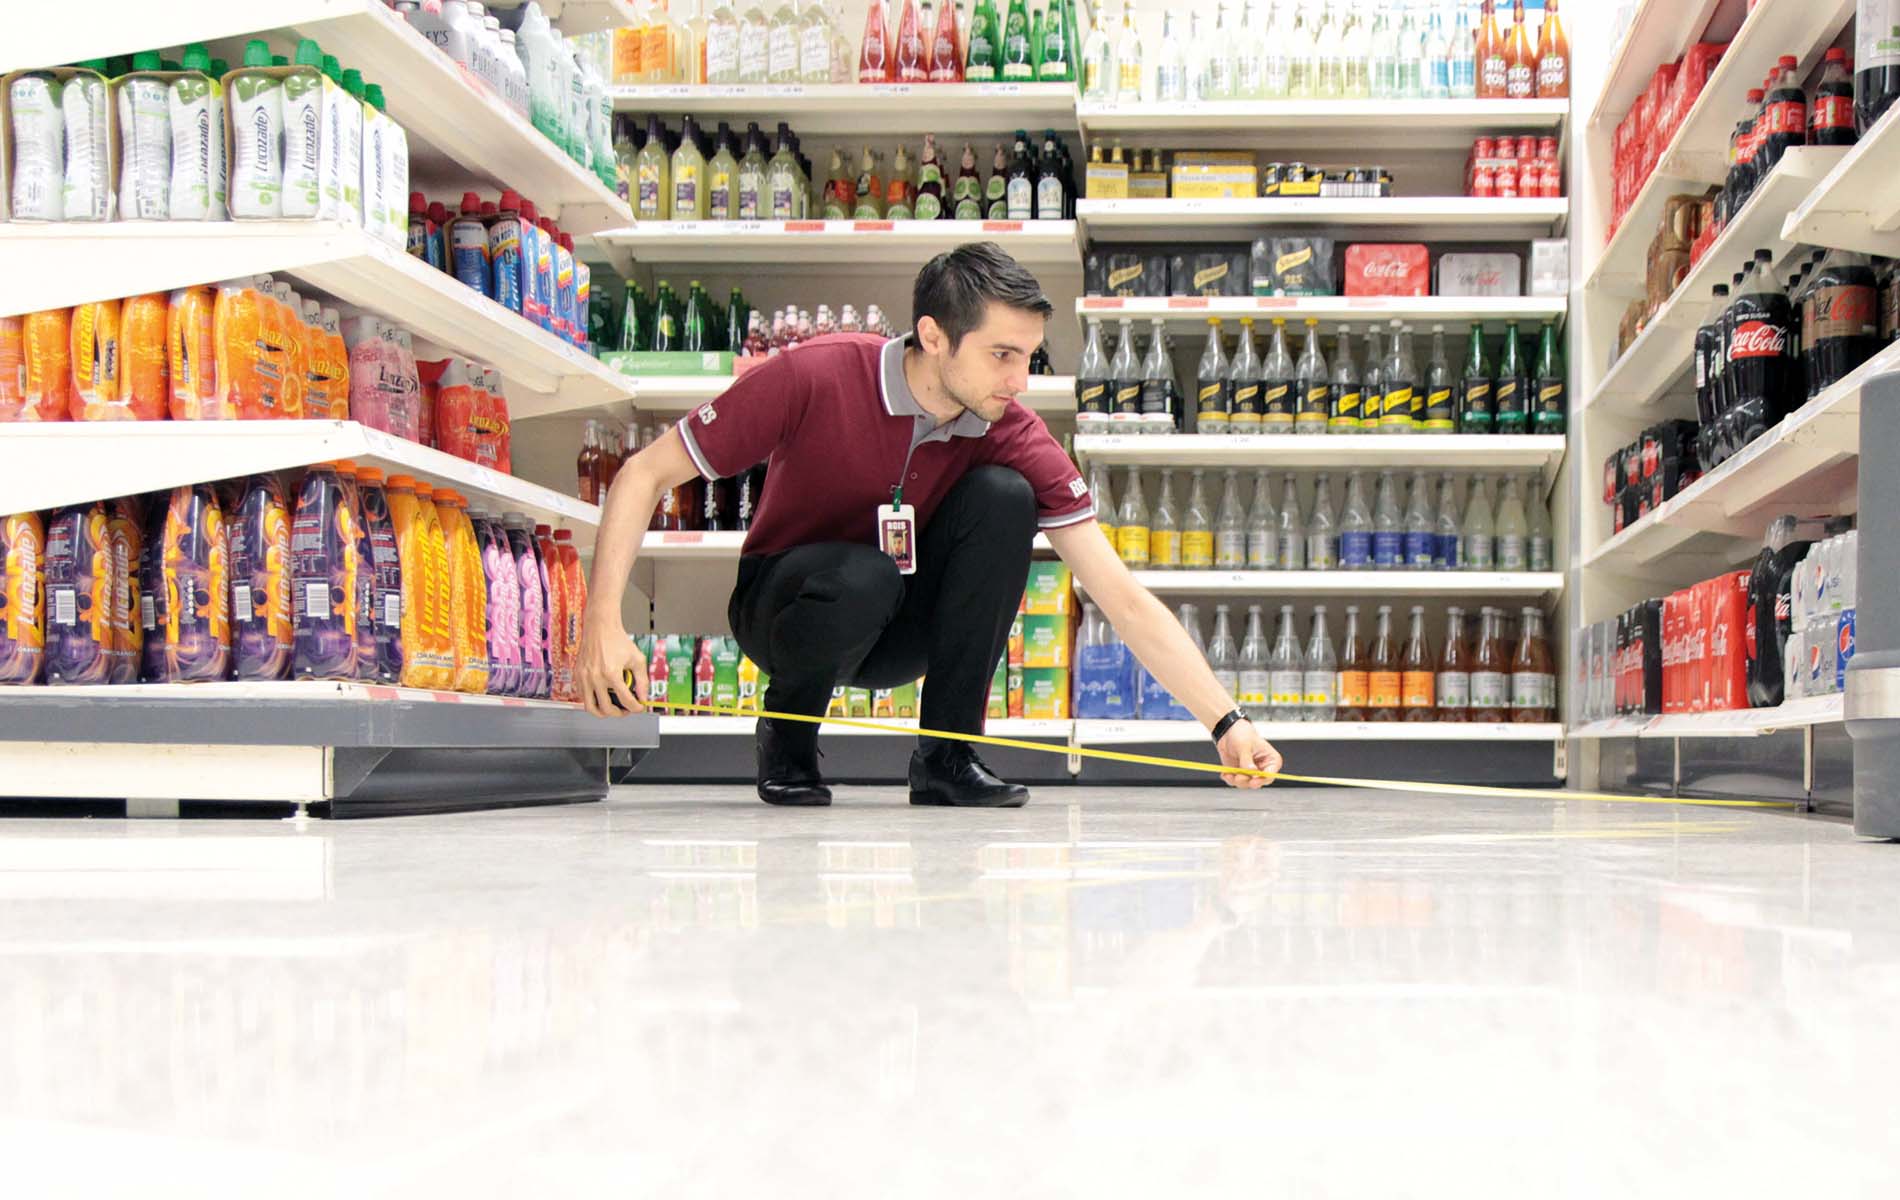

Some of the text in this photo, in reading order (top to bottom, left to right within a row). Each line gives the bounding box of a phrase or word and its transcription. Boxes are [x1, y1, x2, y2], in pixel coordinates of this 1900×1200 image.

[1485, 59, 1505, 71] BIG
[1508, 67, 1530, 79] BIG
[1541, 58, 1563, 70] BIG
[255, 113, 269, 172] Lucozade
[302, 112, 317, 171] Lucozade
[17, 537, 36, 625] Lucozade
[113, 544, 129, 629] Lucozade
[276, 533, 291, 622] Lucozade
[416, 520, 433, 634] Lucozade
[433, 528, 450, 639] Lucozade
